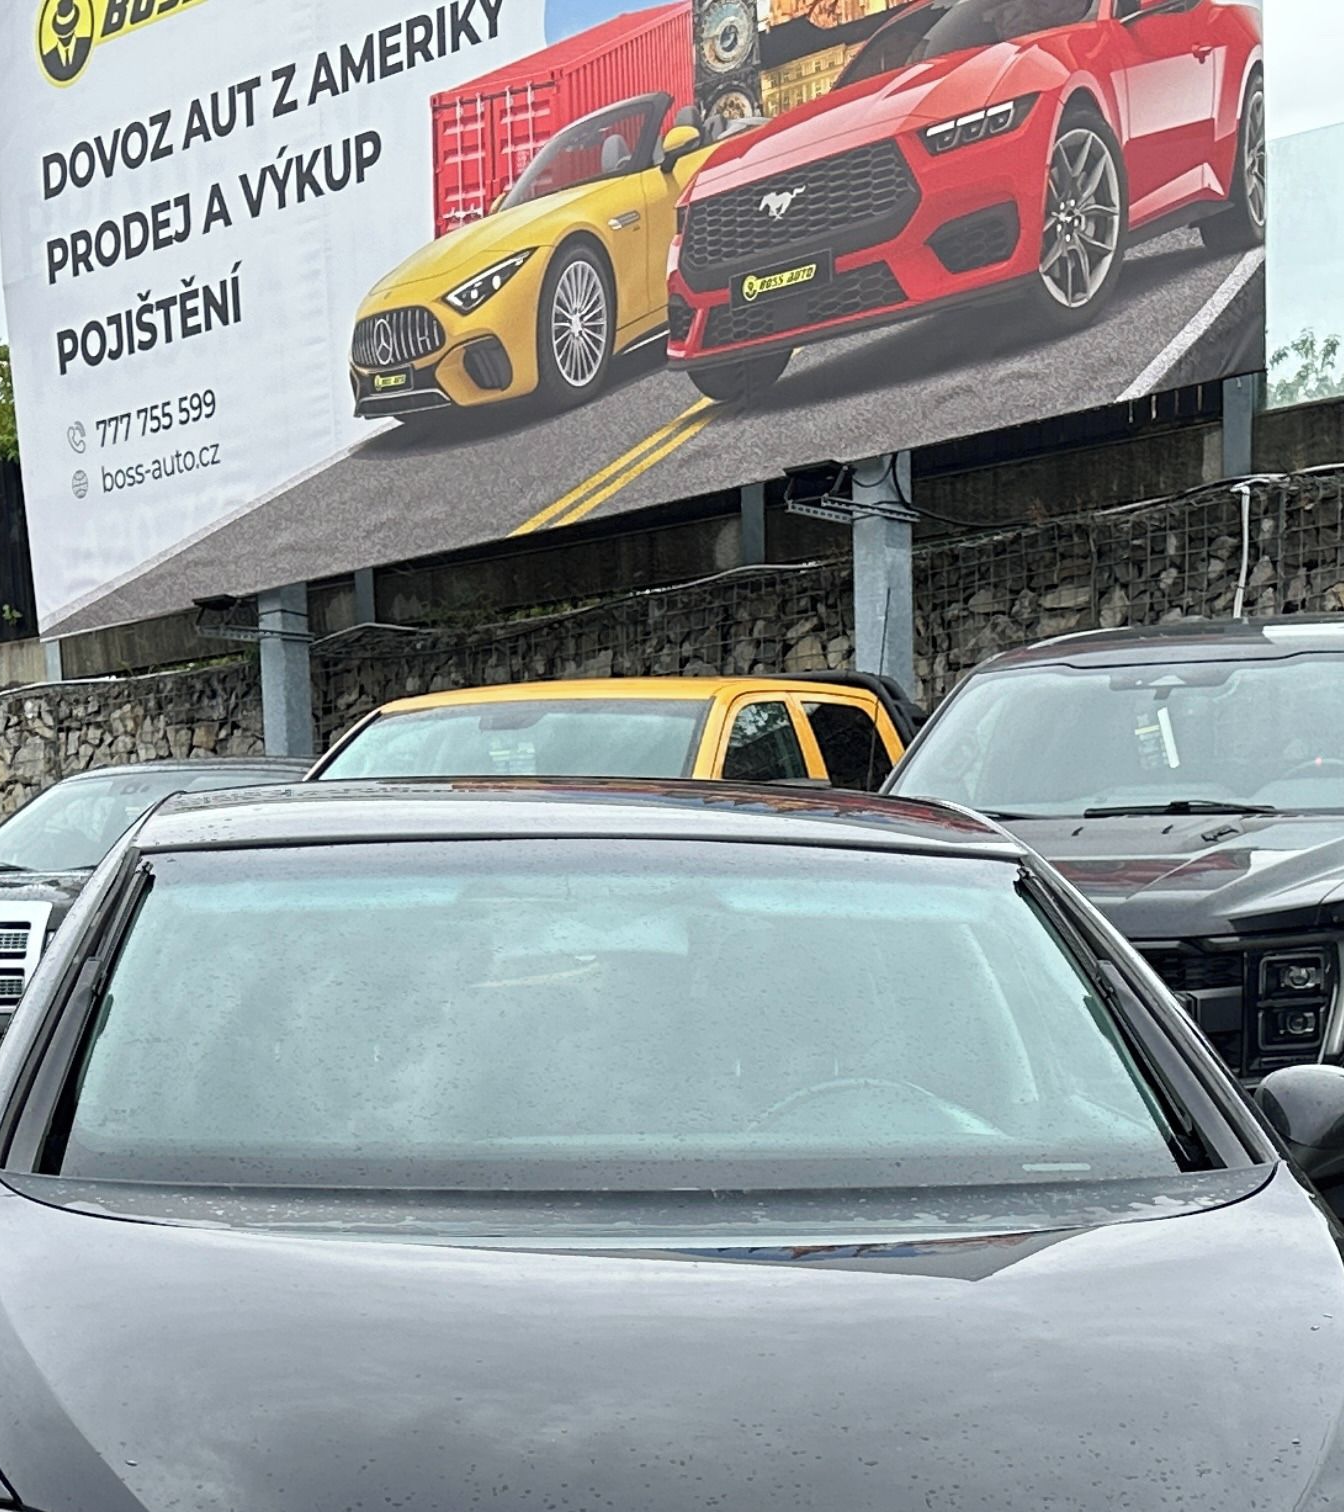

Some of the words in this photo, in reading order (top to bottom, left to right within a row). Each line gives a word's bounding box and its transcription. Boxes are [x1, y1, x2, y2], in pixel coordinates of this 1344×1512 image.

[42, 108, 174, 201] DOVOZ
[182, 75, 261, 151] AUT
[271, 62, 299, 118] Z
[307, 0, 503, 106] AMERIKY
[46, 192, 192, 285] PRODEJ
[202, 182, 233, 235] A
[238, 130, 382, 219] VÝKUP
[56, 260, 242, 376] POJIŠTĚNÍ
[95, 412, 132, 448] 777
[136, 401, 173, 437] 755
[178, 389, 217, 426] 599
[101, 443, 221, 494] boss-auto.cz
